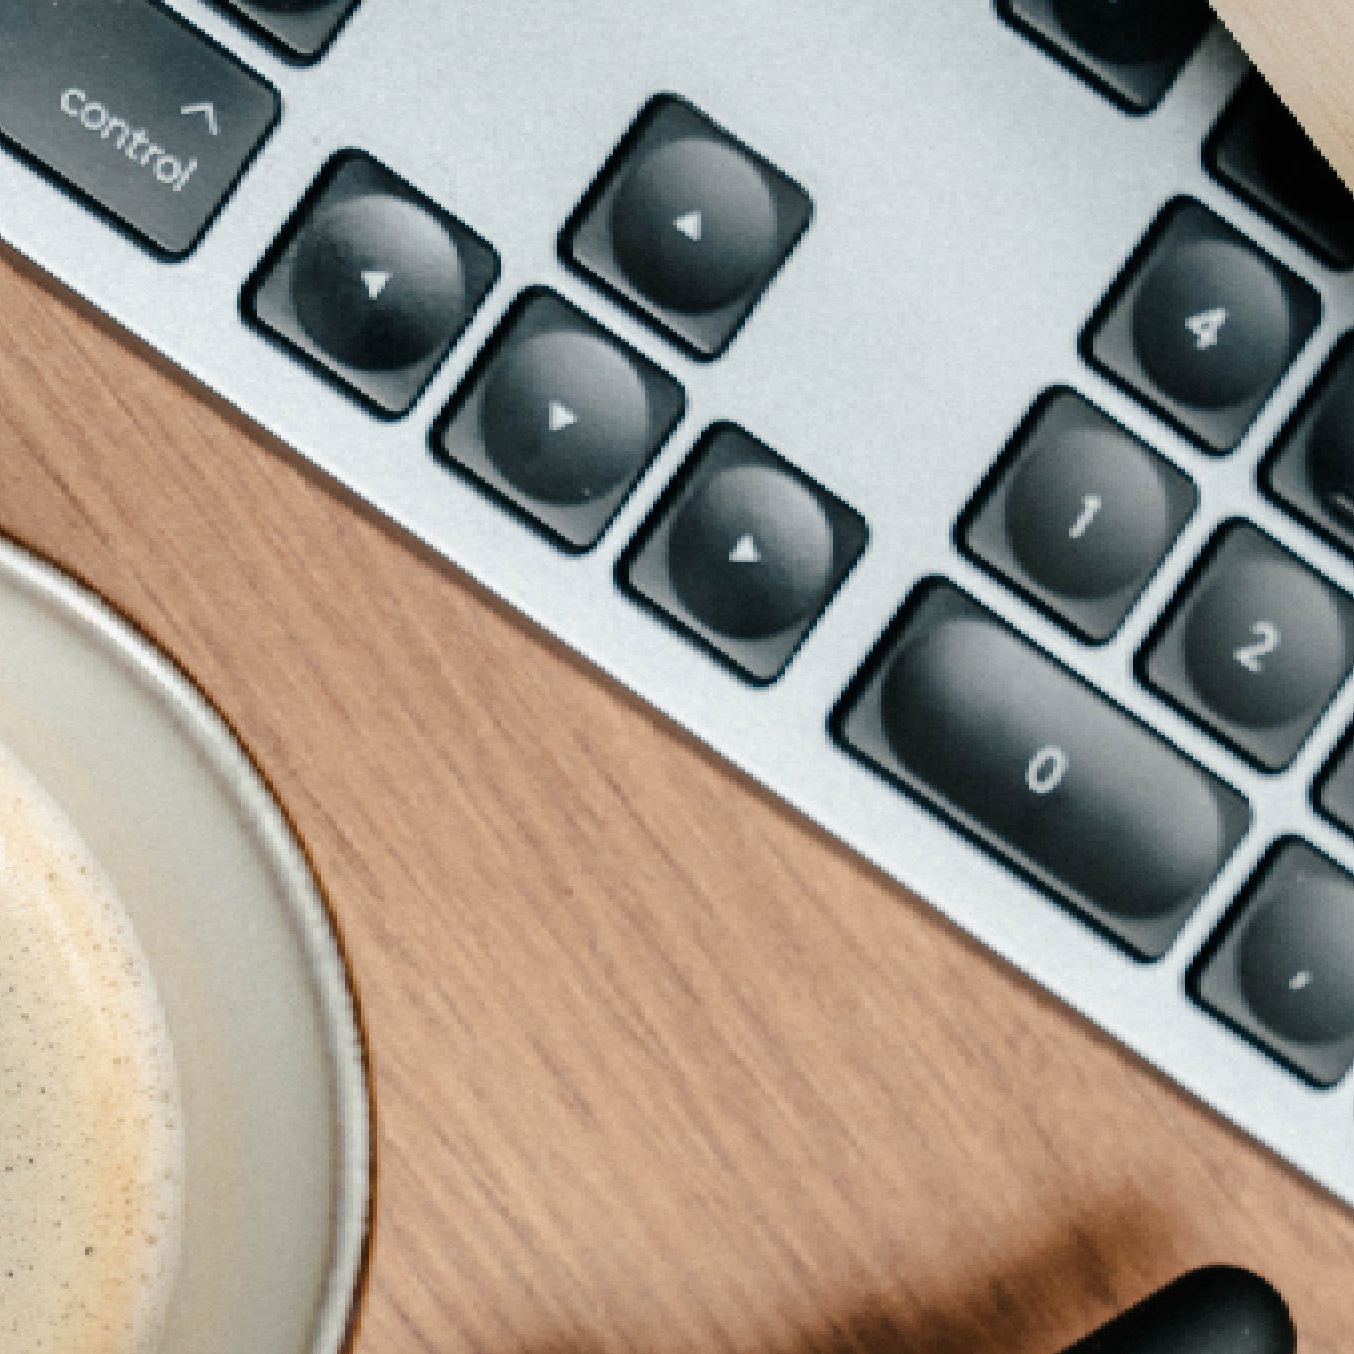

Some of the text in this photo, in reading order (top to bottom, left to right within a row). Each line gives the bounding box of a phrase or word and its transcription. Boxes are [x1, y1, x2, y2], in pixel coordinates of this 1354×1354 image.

[61, 88, 198, 192] control
[1185, 308, 1227, 350] 4
[1069, 495, 1101, 539] 1
[1236, 621, 1280, 671] 2
[1025, 746, 1069, 794] 0
